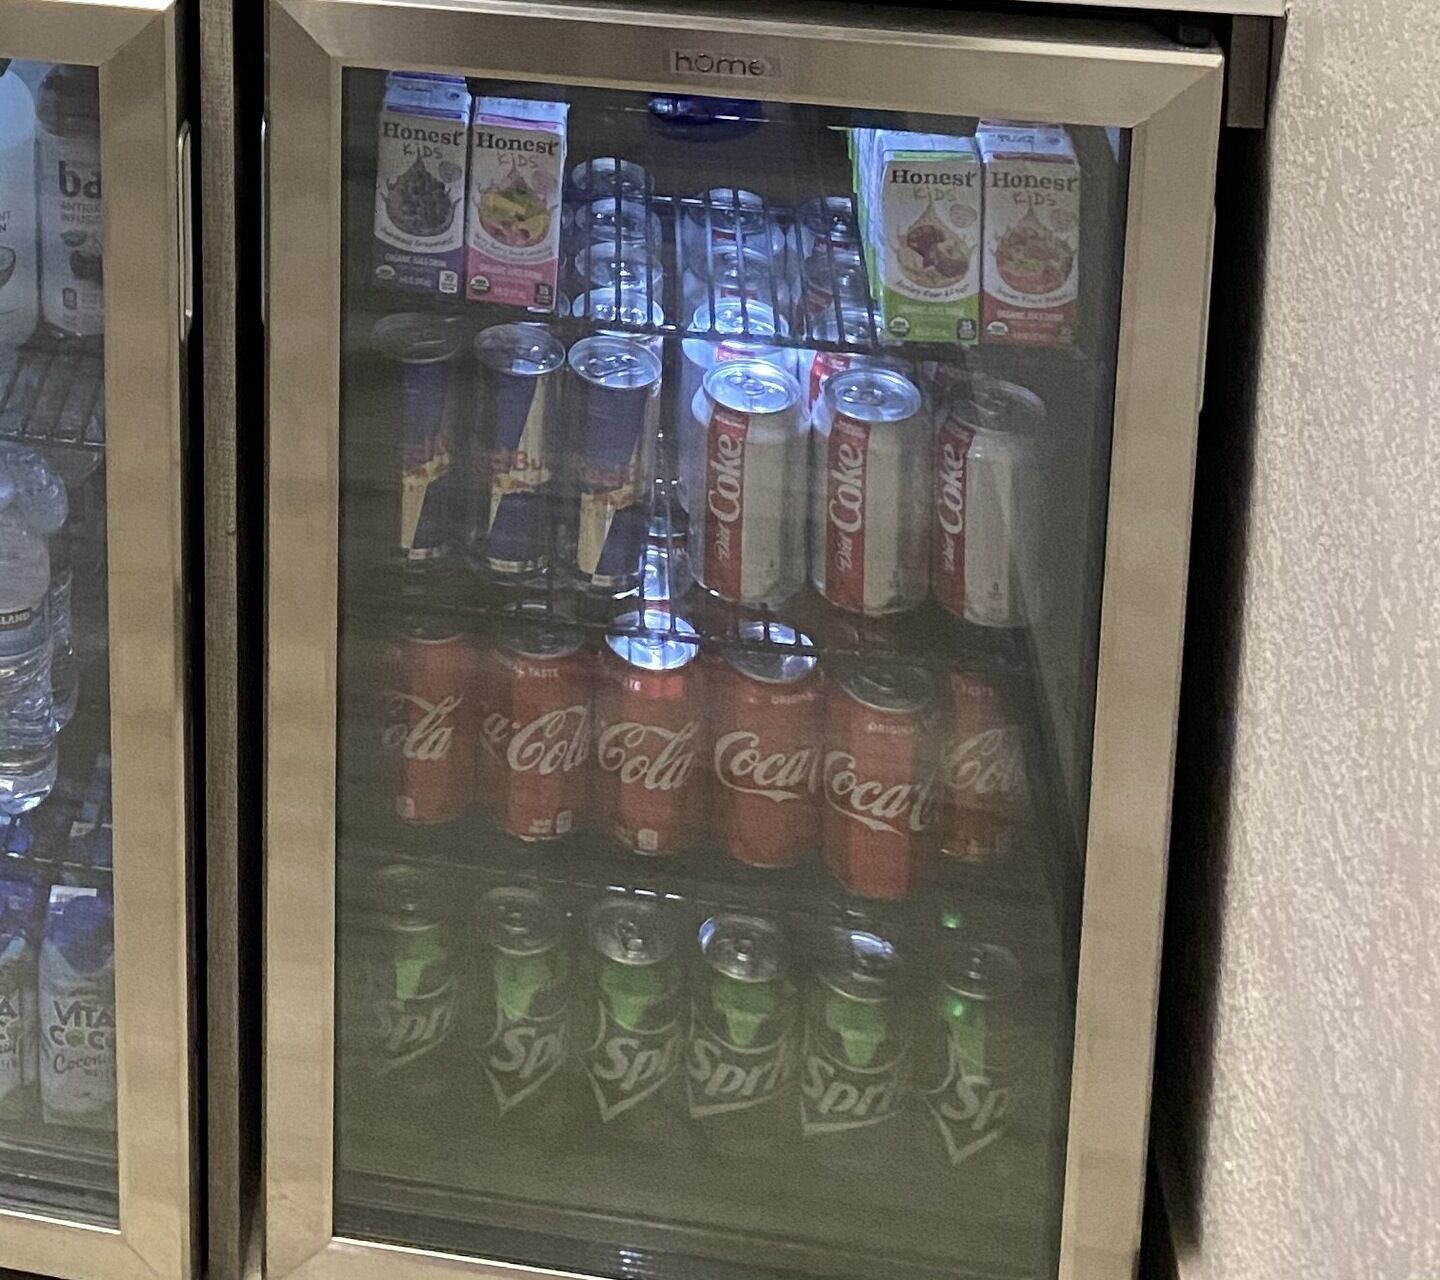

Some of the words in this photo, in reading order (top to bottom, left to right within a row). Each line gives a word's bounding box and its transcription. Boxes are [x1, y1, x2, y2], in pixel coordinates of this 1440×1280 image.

[675, 50, 762, 76] home
[383, 121, 463, 147] Honest
[476, 131, 559, 157] Honest
[891, 169, 977, 188] Honest
[991, 172, 1079, 192] Honest
[708, 434, 742, 523] Coke
[829, 443, 864, 533] Coke
[939, 442, 965, 535] Coke
[598, 721, 696, 791] Cola
[714, 731, 811, 793] Coca
[53, 999, 116, 1028] VITA
